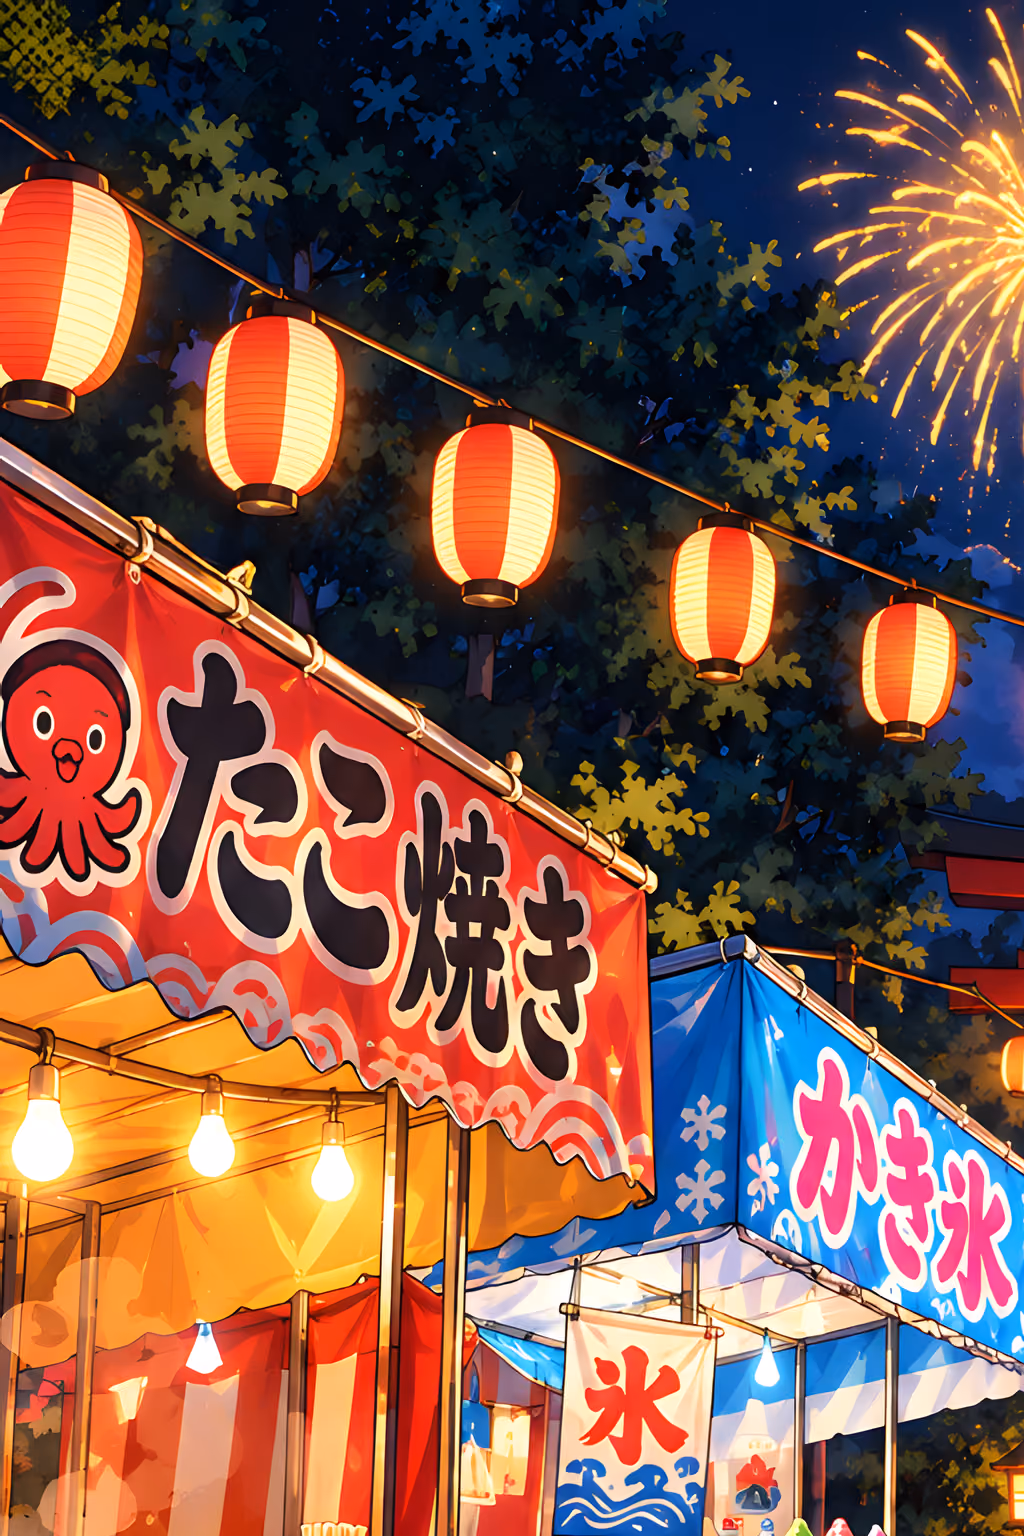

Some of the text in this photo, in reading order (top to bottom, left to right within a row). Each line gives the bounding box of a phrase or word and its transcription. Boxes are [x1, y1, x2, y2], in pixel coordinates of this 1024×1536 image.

[154, 648, 592, 1083] たこ焼き
[796, 1057, 1014, 1312] かき氷
[578, 1344, 690, 1466] 氷
